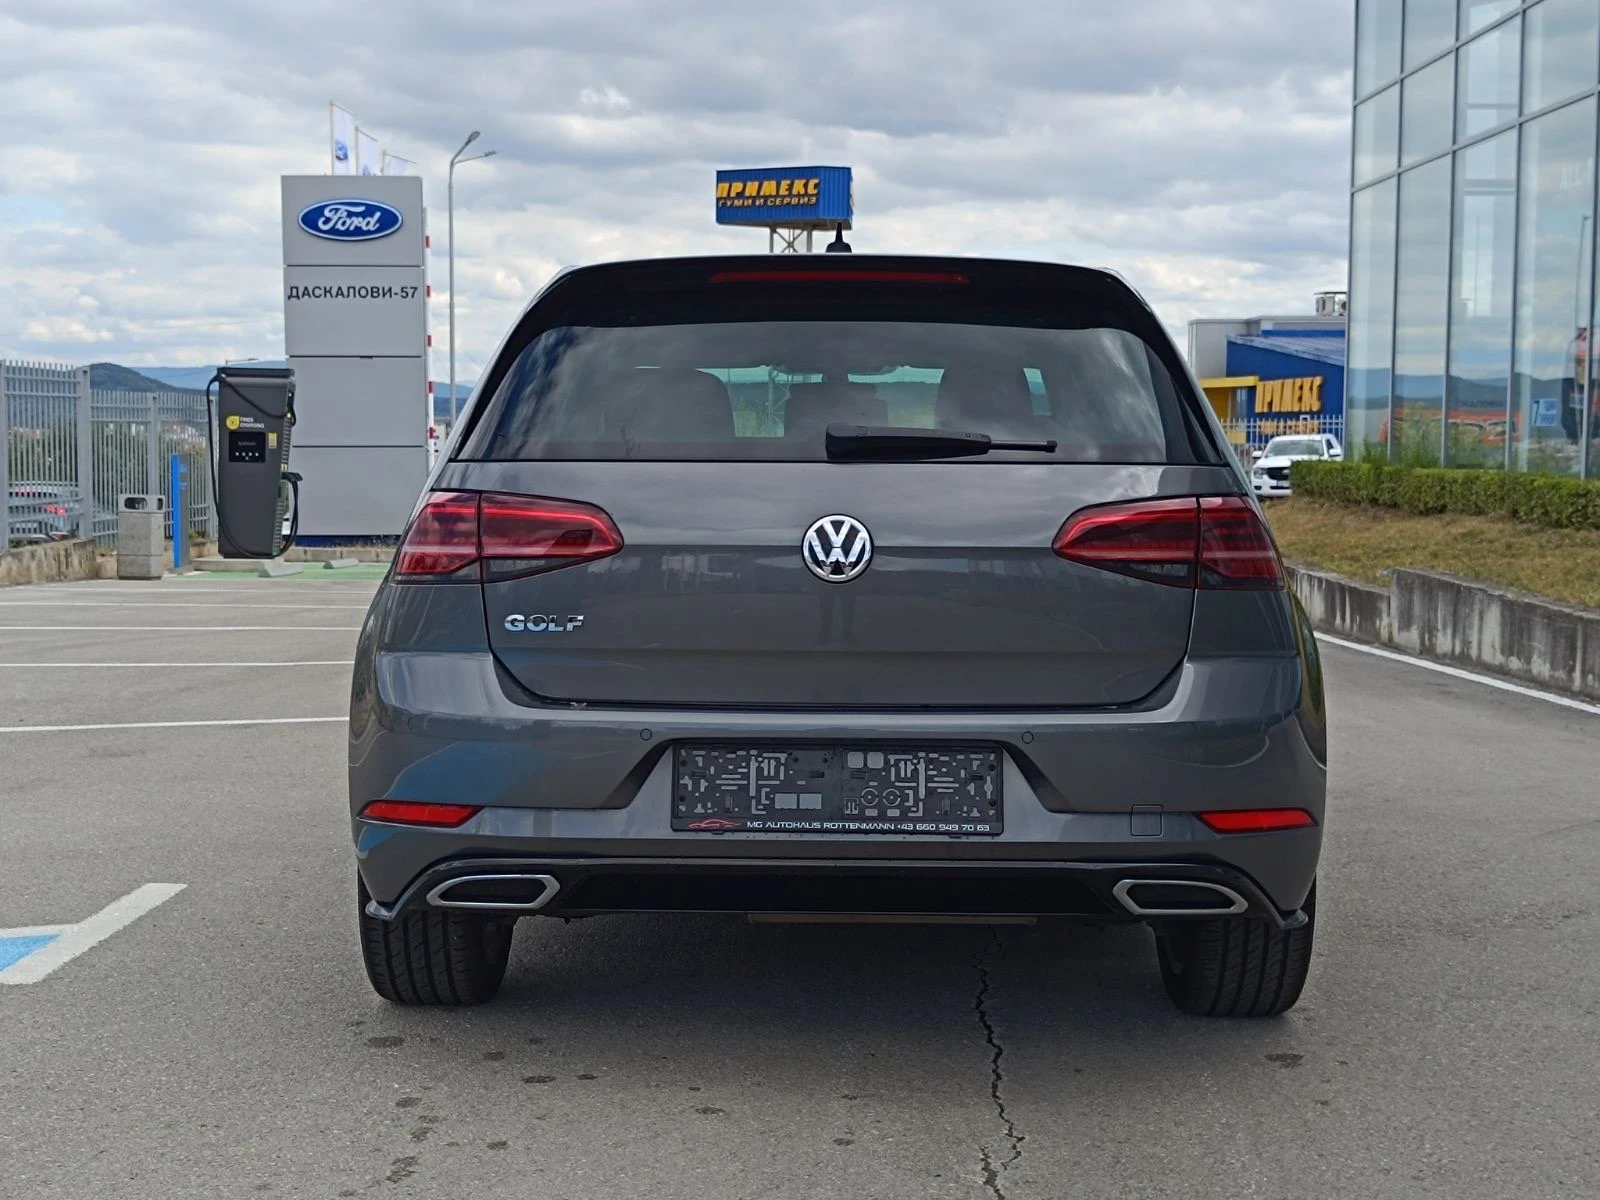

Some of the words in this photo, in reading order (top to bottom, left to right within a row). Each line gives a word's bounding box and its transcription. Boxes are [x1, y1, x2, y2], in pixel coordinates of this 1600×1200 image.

[716, 179, 819, 198] ПРИМЕКС
[719, 198, 752, 207] ГУМИ
[755, 198, 764, 206] И
[767, 196, 817, 206] СЕРВИЗ
[317, 204, 382, 232] Ford
[287, 285, 418, 300] ДАСКАЛОВИ-57
[504, 613, 585, 632] GOLF
[746, 821, 763, 829] MG
[765, 821, 821, 829] AUTOHAUS
[823, 822, 895, 830] ROTTENMANN
[916, 823, 936, 831] 660
[976, 824, 990, 832] 63
